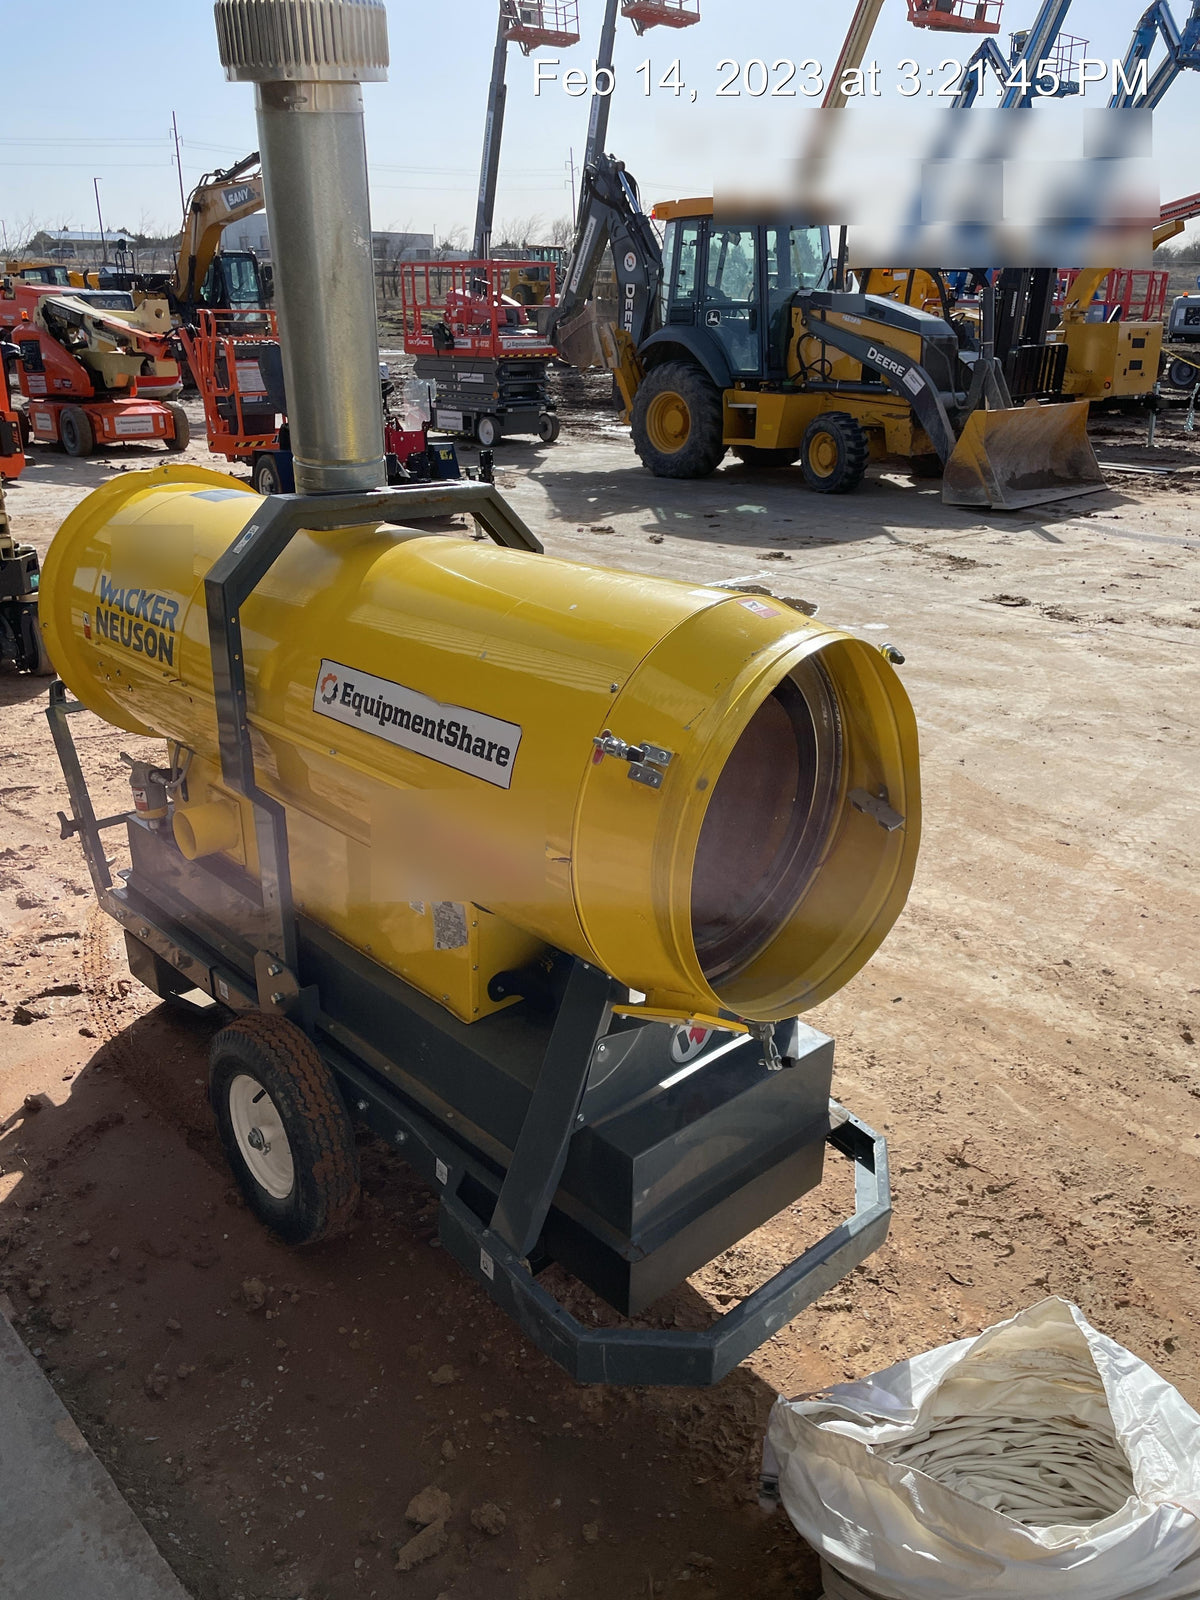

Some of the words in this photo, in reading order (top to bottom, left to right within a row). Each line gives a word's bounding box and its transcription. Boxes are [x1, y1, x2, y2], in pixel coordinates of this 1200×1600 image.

[228, 187, 249, 206] SANY
[866, 346, 906, 377] DEERE
[101, 575, 180, 633] WACKER
[96, 606, 174, 667] NEUSON
[339, 681, 511, 768] EquipmentShare
